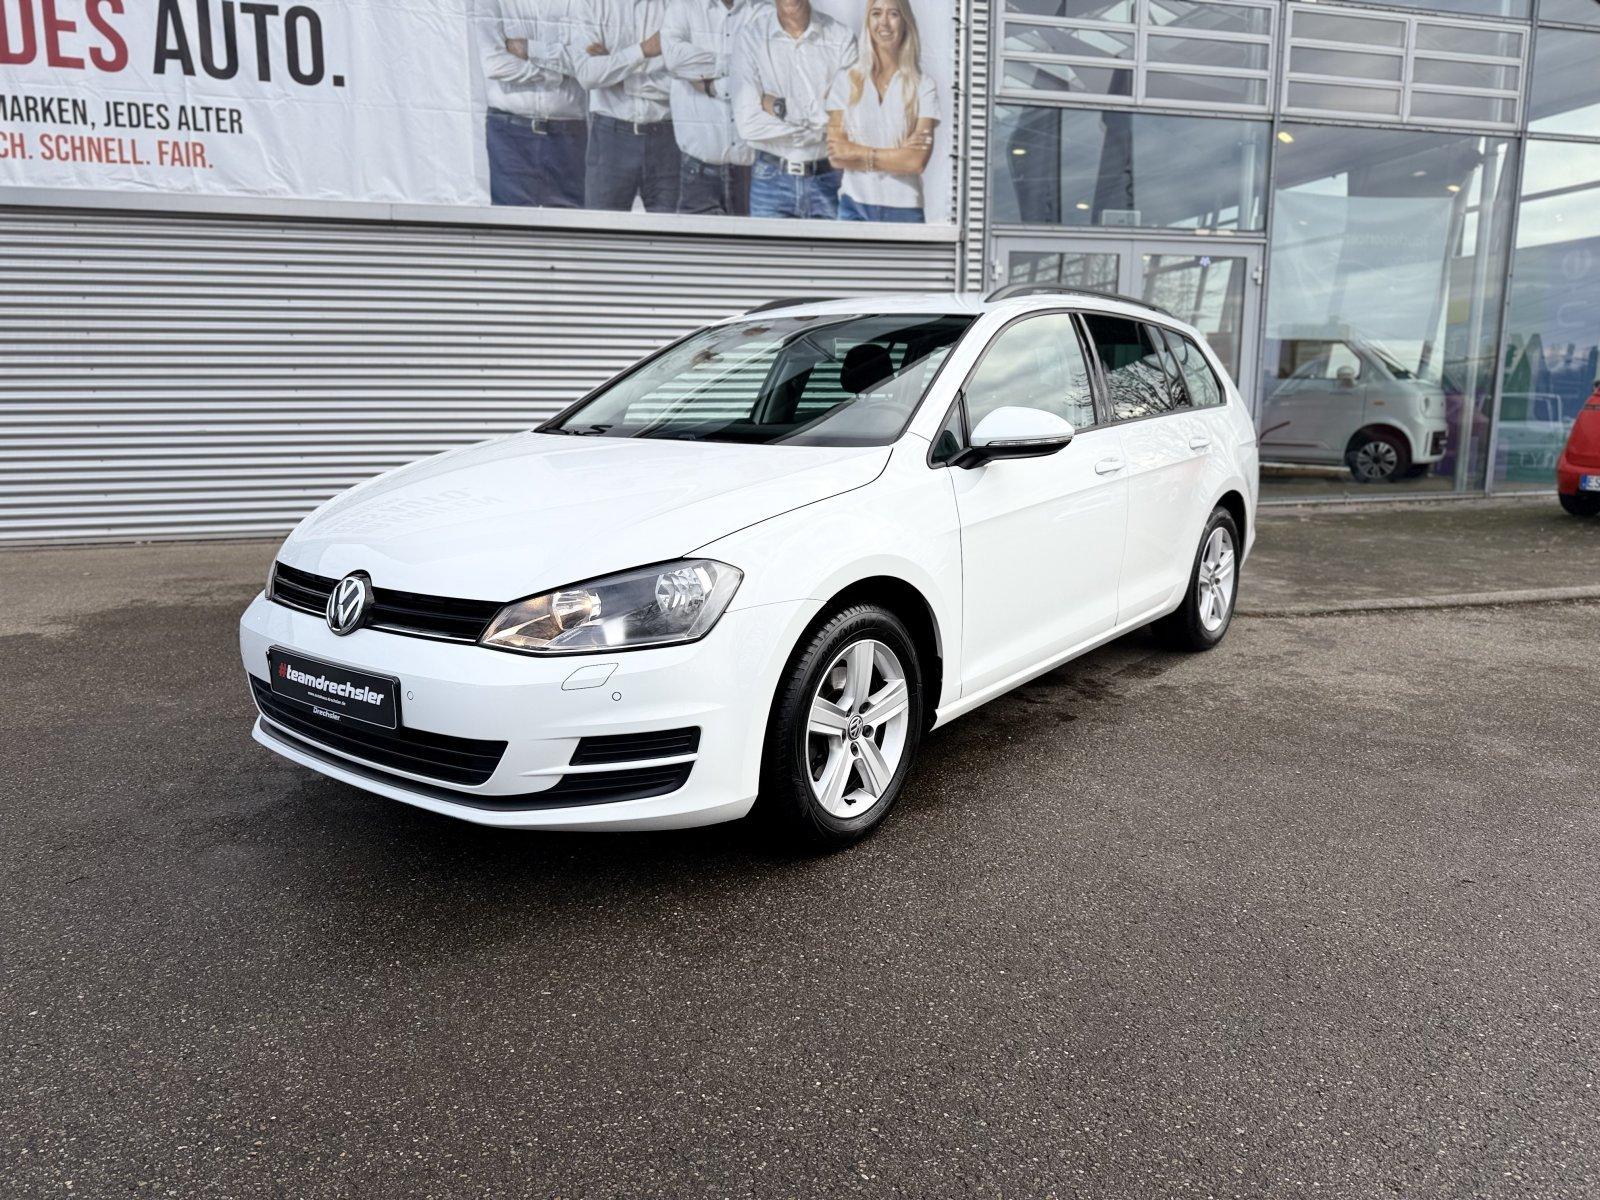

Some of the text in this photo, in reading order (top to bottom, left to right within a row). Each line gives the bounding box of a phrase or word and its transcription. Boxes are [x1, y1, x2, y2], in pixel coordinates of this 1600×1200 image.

[153, 0, 345, 87] AUTO.
[103, 101, 170, 130] JEDES
[177, 104, 244, 134] ALTER
[40, 133, 151, 165] SCHNELL.
[157, 139, 214, 169] FAIR.
[278, 663, 385, 705] #teamdrechsler
